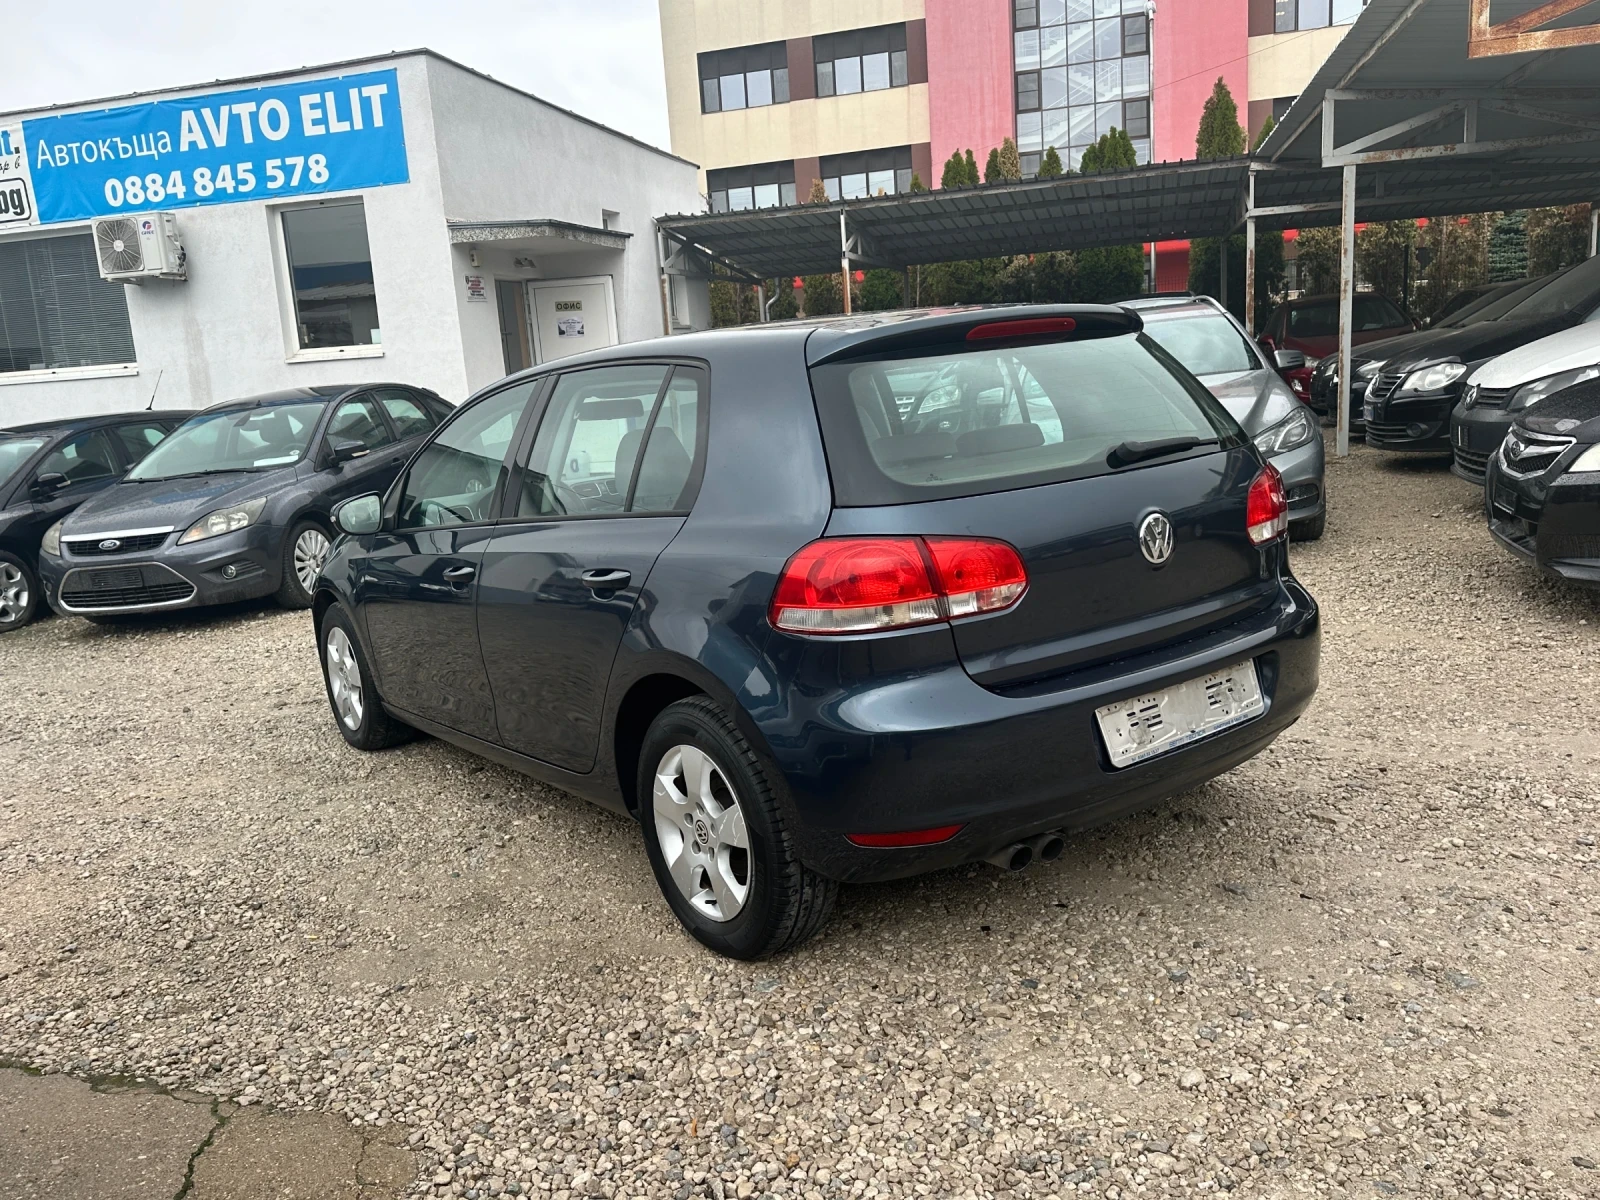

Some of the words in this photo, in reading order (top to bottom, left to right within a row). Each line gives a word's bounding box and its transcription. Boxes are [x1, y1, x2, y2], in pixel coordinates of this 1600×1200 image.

[37, 130, 172, 169] Автокъща
[180, 99, 290, 152] AVTO
[300, 84, 388, 137] ELIT
[104, 174, 186, 207] 0884
[193, 161, 256, 197] 845
[266, 154, 330, 189] 578
[556, 302, 581, 311] ОФИС
